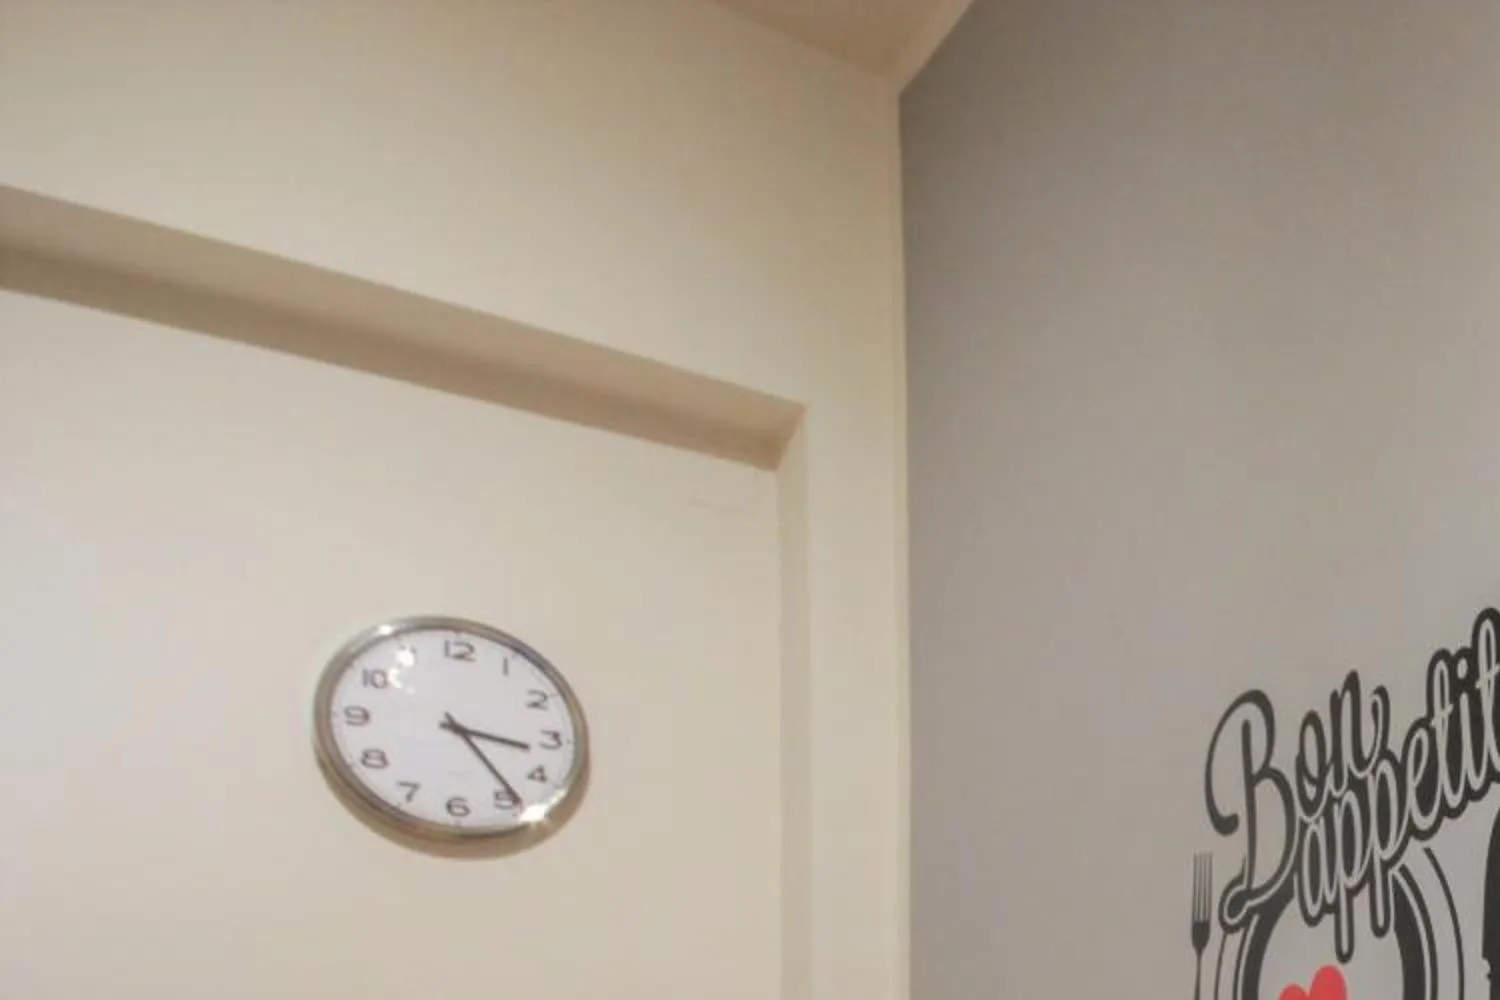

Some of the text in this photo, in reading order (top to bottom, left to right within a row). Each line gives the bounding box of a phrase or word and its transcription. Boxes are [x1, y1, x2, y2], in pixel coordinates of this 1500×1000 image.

[445, 640, 476, 662] 12
[502, 657, 509, 676] 1
[361, 669, 389, 690] 10
[526, 689, 549, 710] 2
[343, 705, 371, 726] 9
[540, 730, 562, 750] 3
[360, 748, 389, 769] 8
[526, 765, 548, 783] 4
[397, 781, 421, 803] 7
[493, 789, 519, 810] 5
[1205, 669, 1391, 934] Bon
[445, 796, 471, 818] 6
